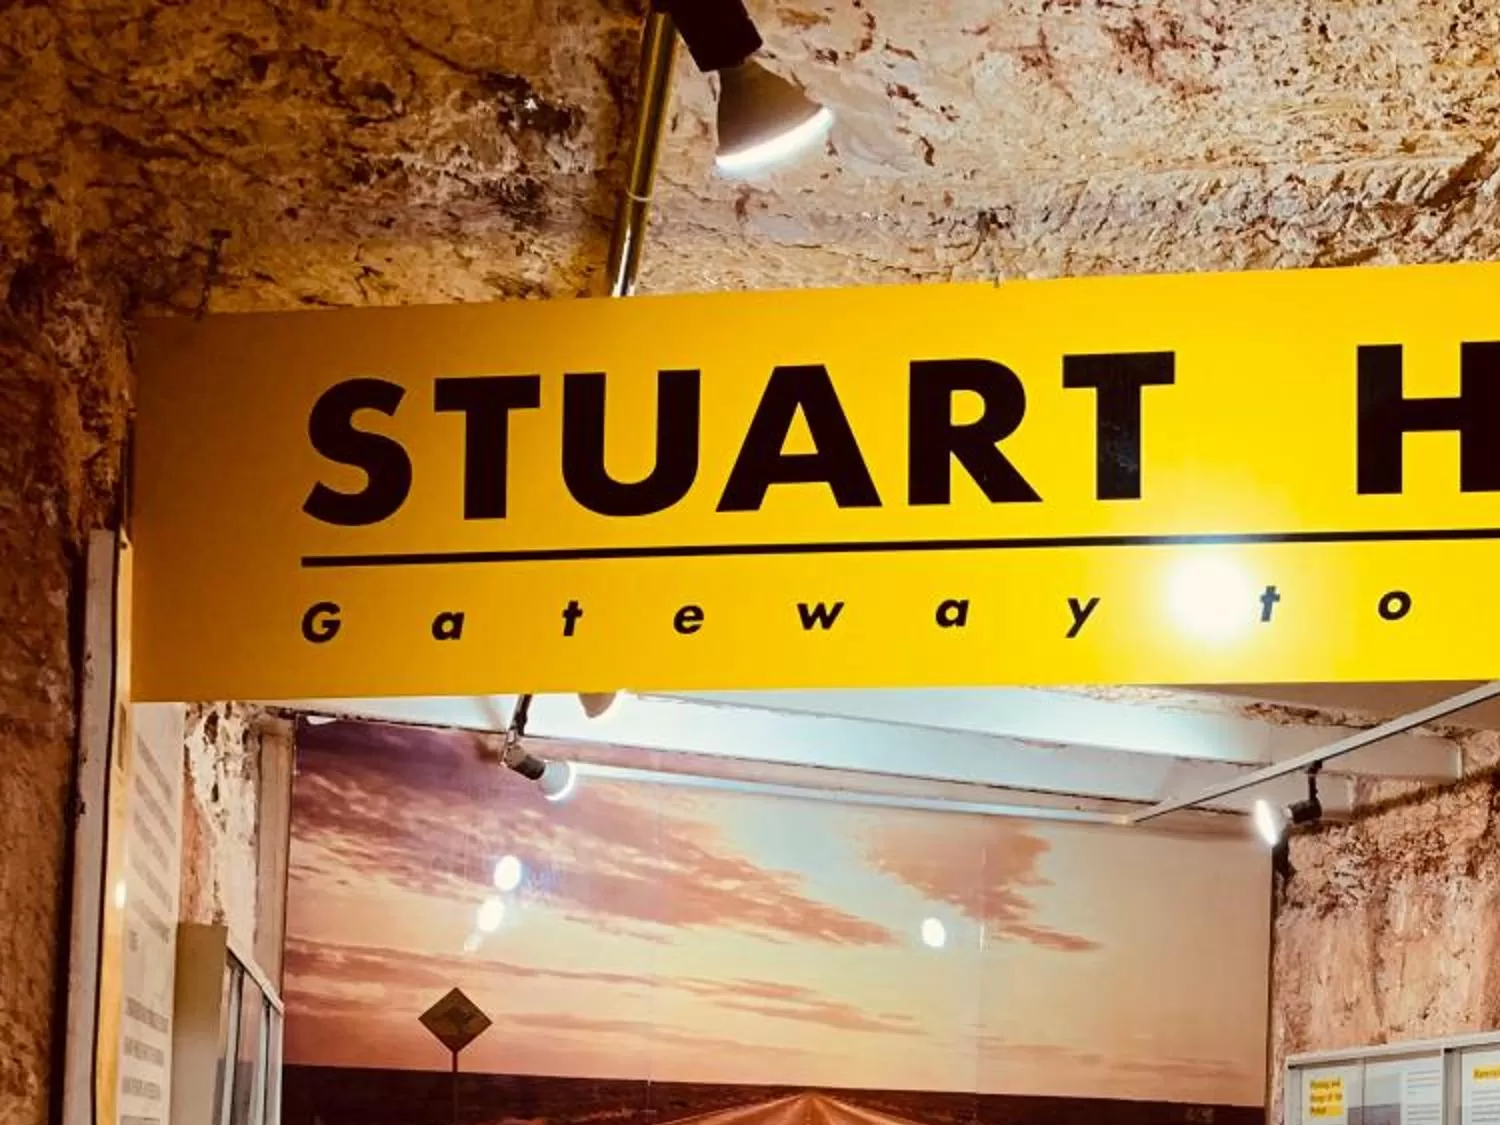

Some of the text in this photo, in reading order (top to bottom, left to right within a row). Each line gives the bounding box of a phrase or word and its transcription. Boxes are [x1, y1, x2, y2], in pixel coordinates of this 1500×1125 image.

[302, 352, 1174, 526] STUART
[302, 599, 1098, 643] Gateway
[1262, 587, 1411, 621] to
